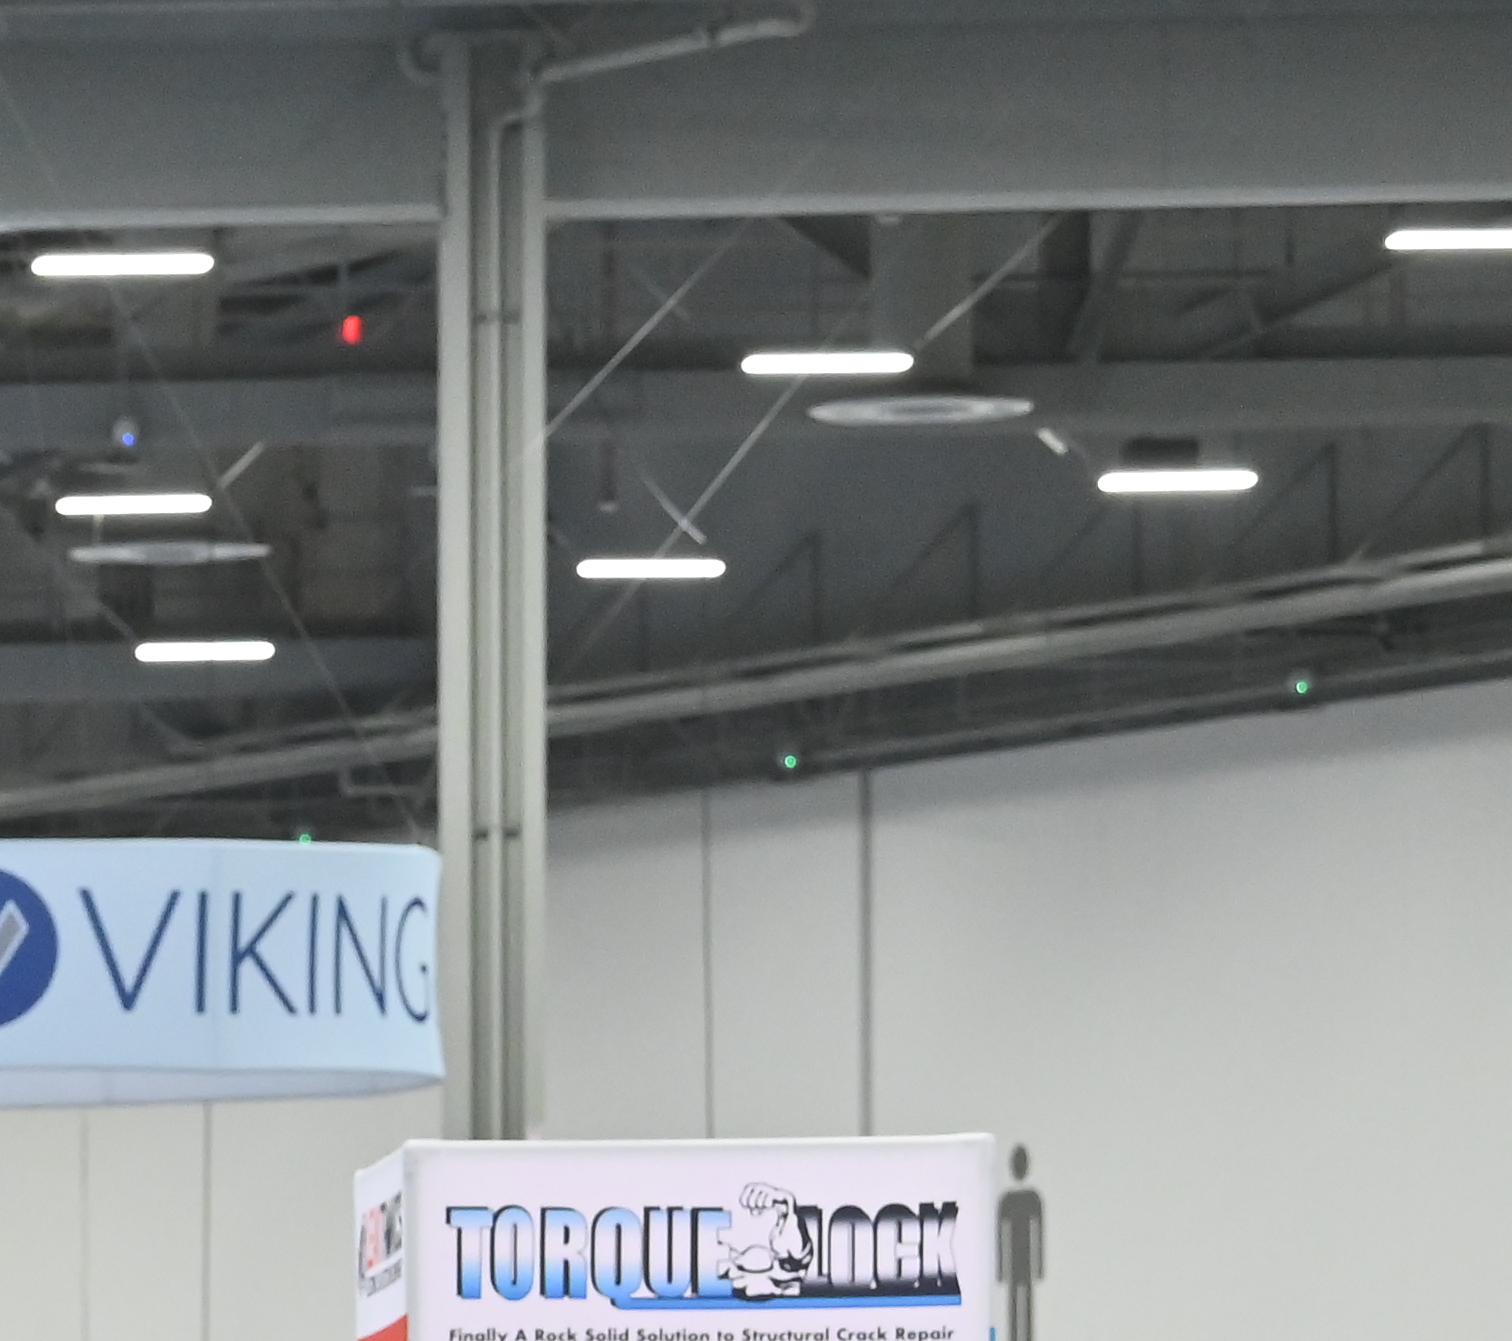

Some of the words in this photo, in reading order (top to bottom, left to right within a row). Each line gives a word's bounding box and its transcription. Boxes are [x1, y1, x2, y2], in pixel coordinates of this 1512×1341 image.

[80, 887, 432, 1024] VIKING
[445, 1204, 733, 1301] TORQUE
[836, 1326, 888, 1341] Crack
